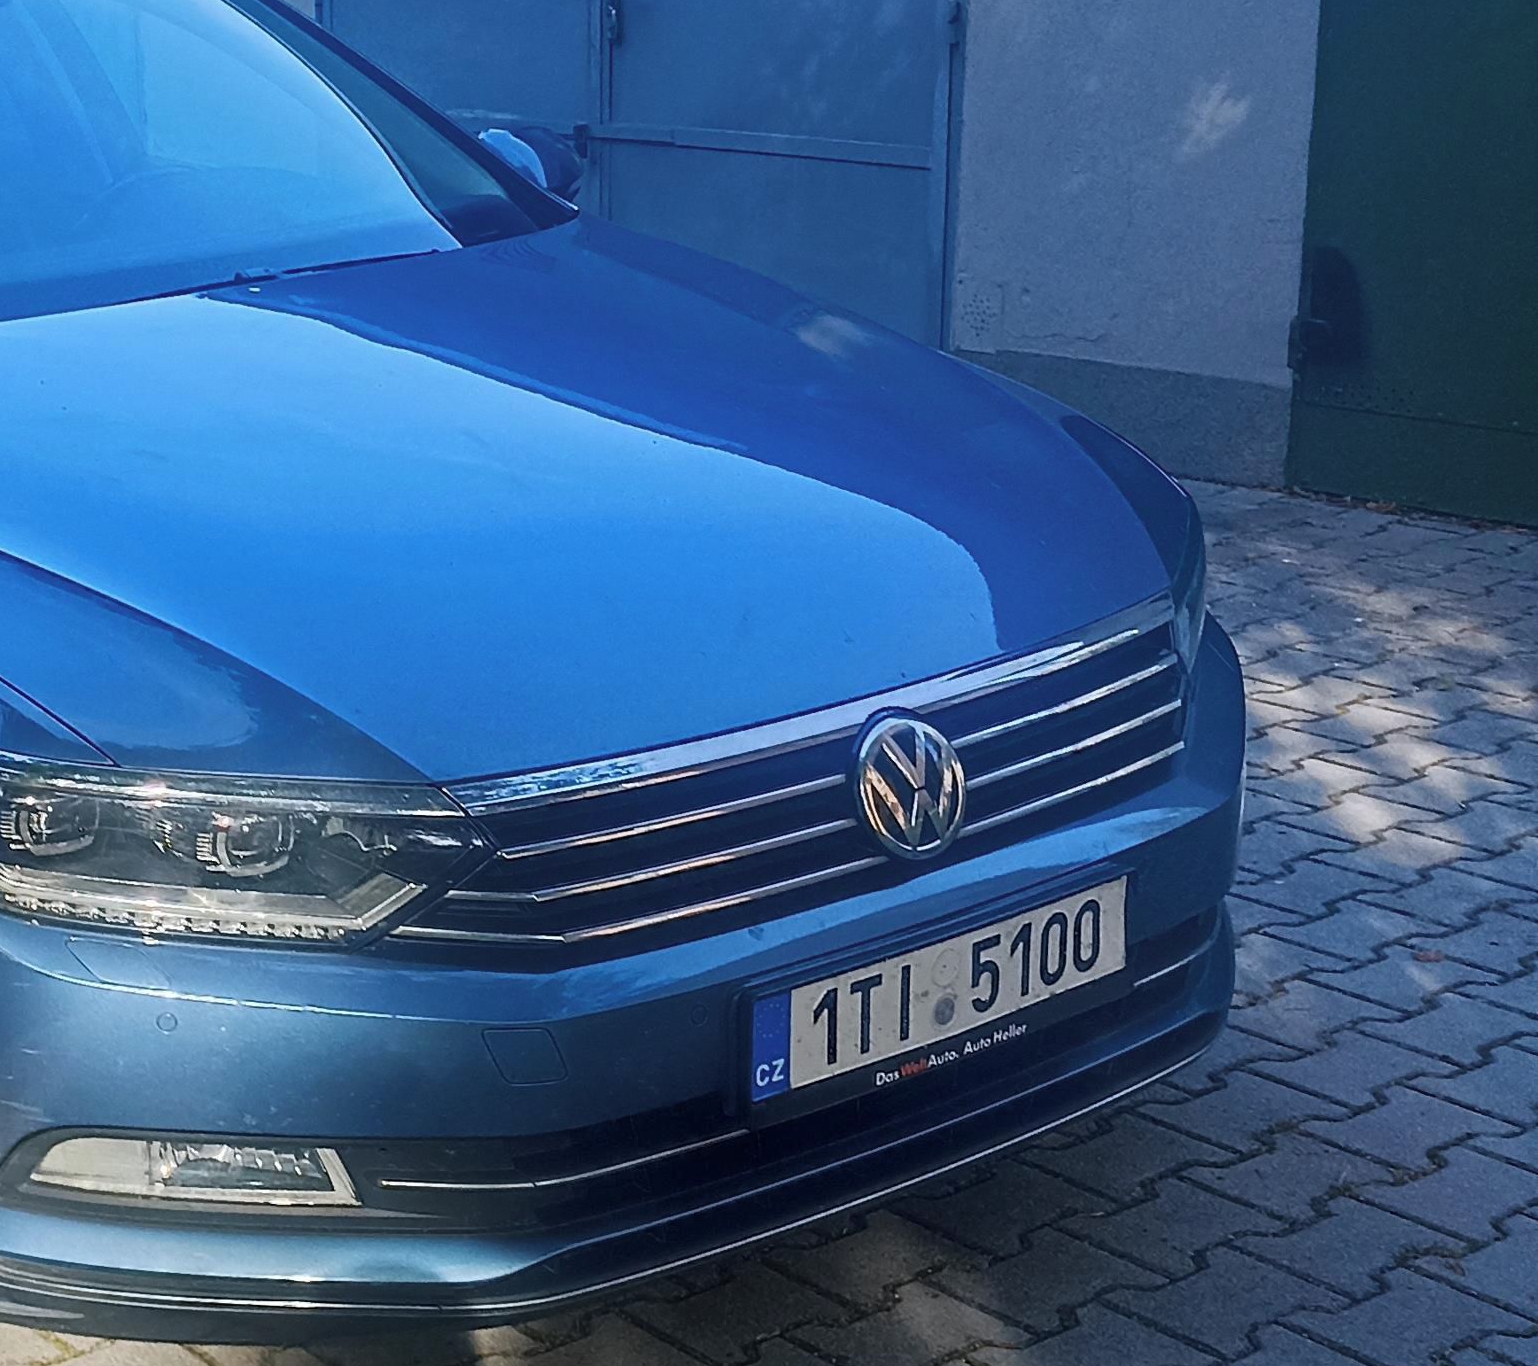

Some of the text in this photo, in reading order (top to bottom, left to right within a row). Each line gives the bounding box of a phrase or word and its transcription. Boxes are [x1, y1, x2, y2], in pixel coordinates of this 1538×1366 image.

[812, 898, 1101, 1065] 1TI 5100
[756, 1057, 785, 1087] CZ
[875, 1069, 900, 1086] Das
[963, 1037, 992, 1055] Auto
